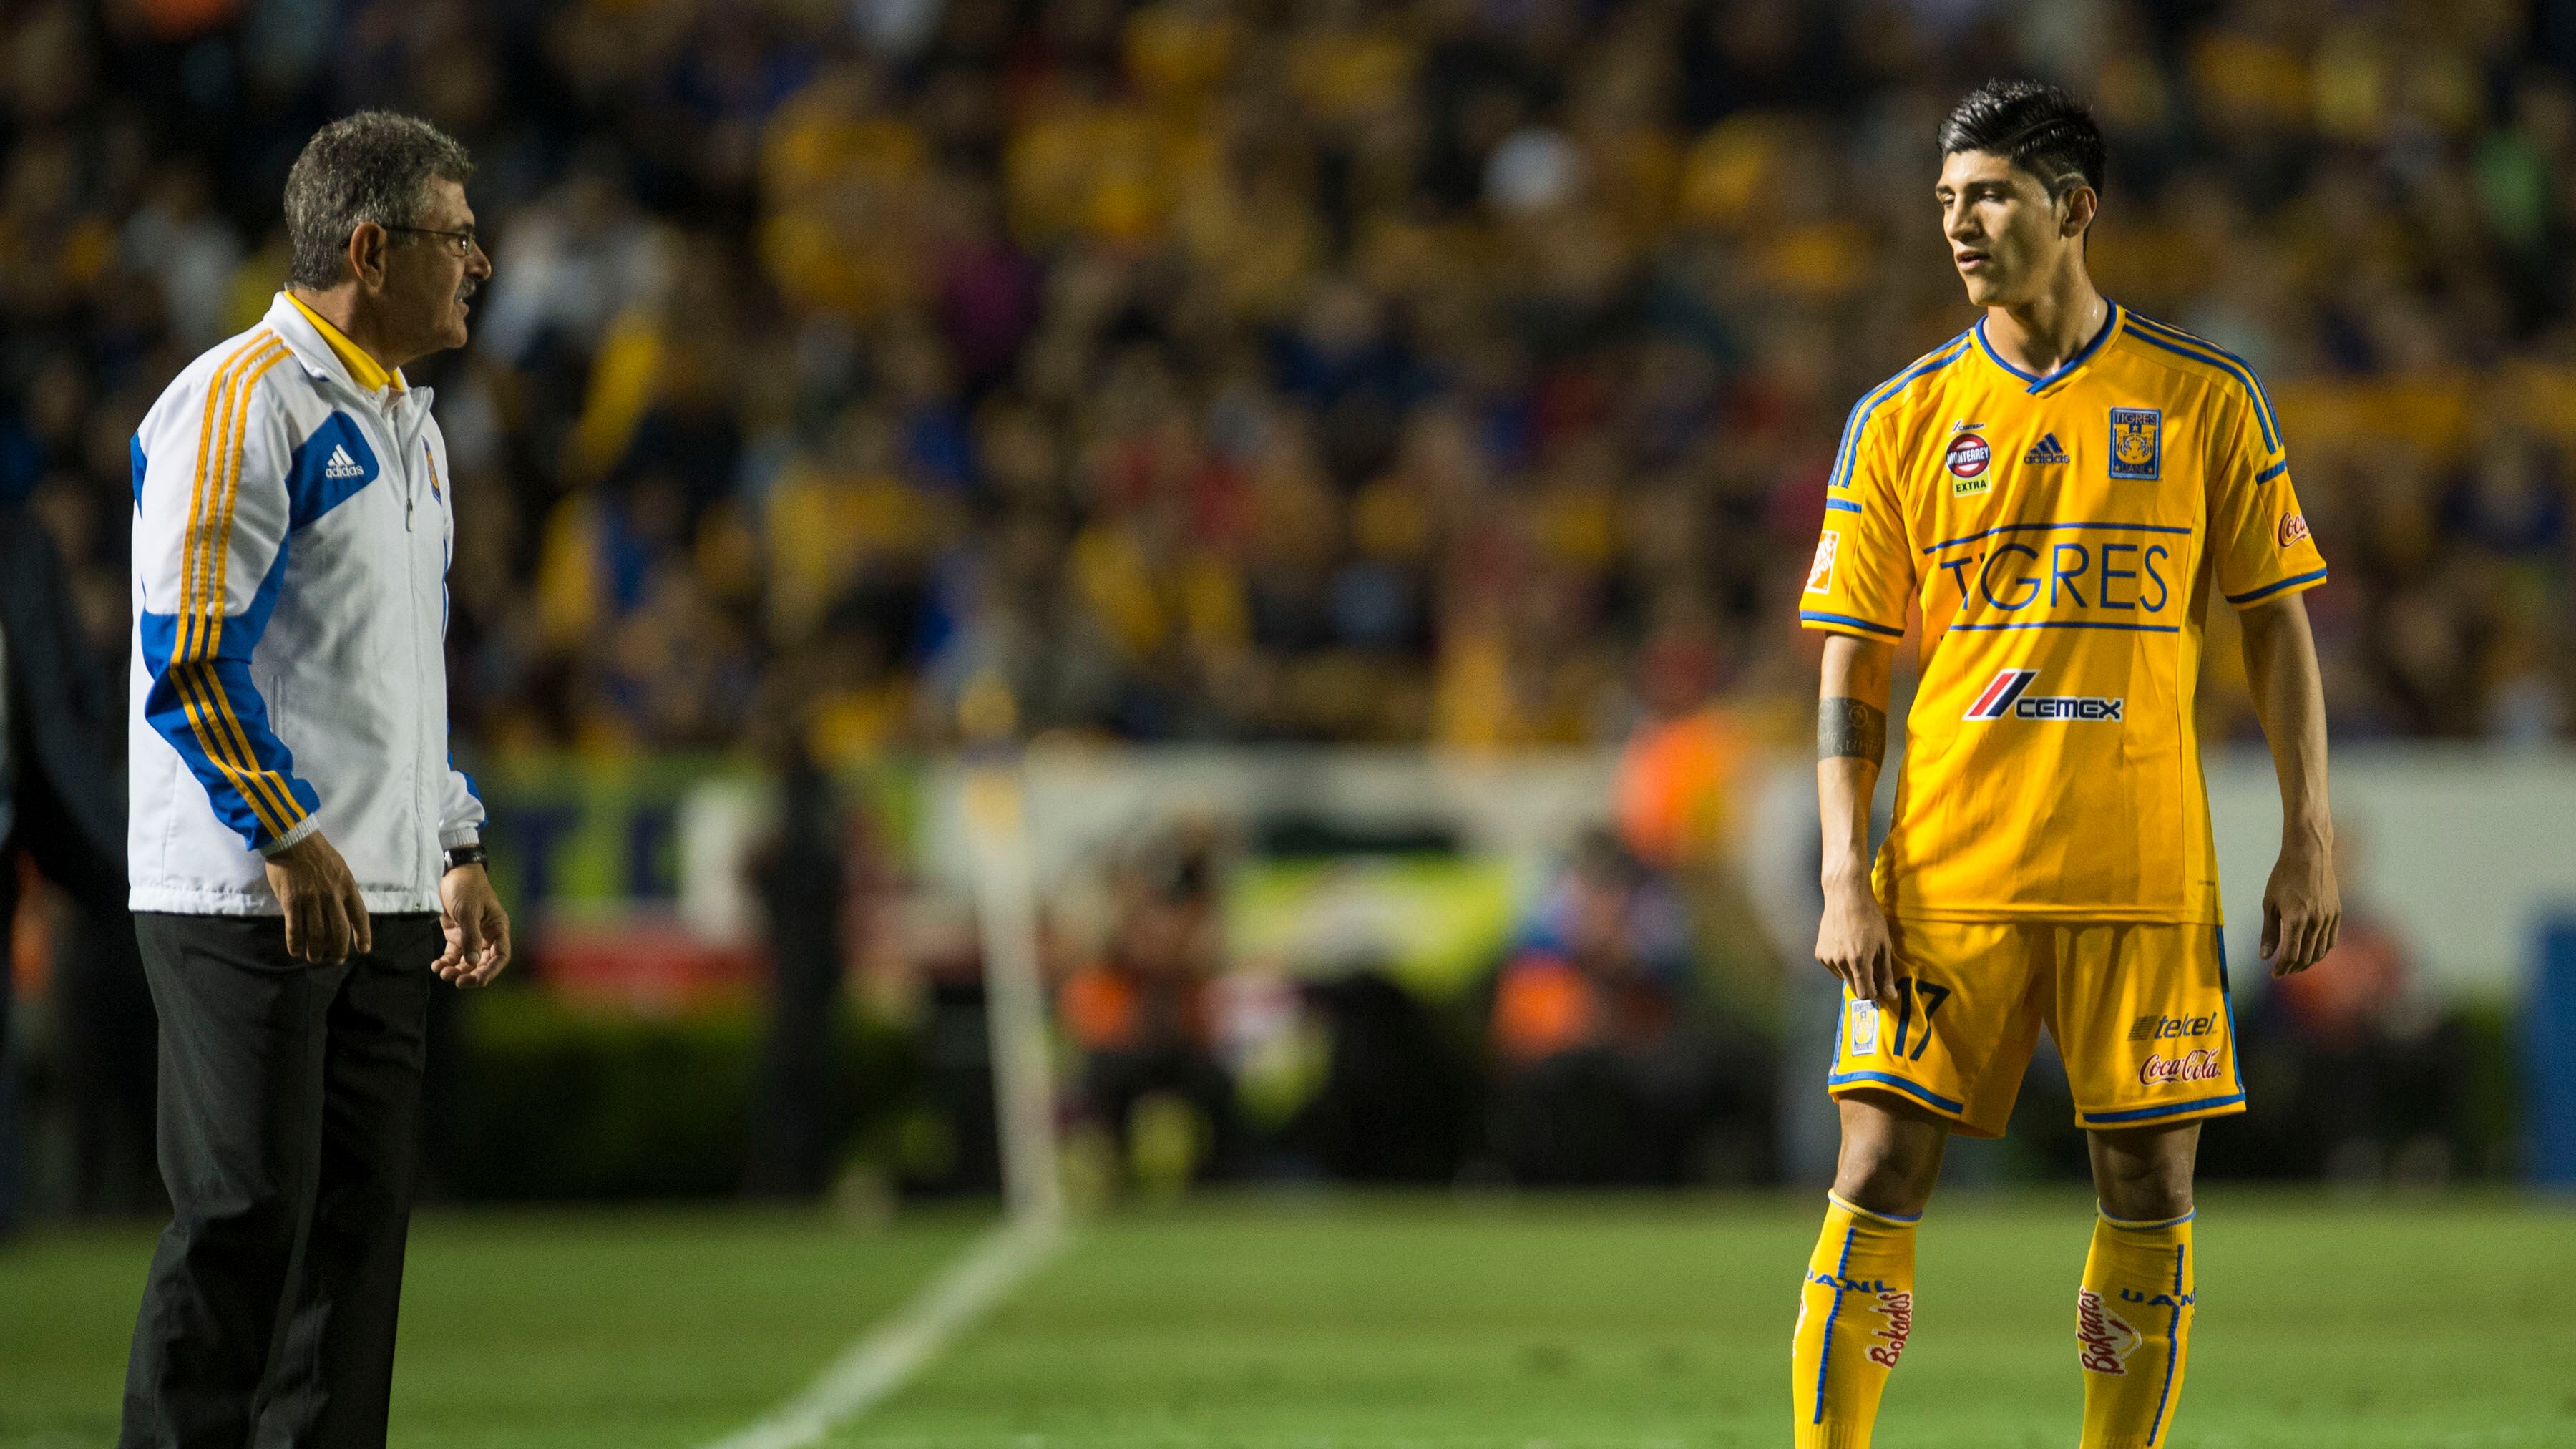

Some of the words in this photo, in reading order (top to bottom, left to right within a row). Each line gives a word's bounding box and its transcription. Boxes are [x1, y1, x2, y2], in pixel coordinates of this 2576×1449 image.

[2115, 412, 2156, 424] TIGRES
[1947, 447, 1989, 464] MONTERREY
[2024, 452, 2070, 464] adidas
[326, 464, 364, 478] adidas
[1956, 480, 1986, 492] EXTRA
[1940, 543, 2168, 613] TGRES
[2016, 698, 2122, 718] CEMEX
[1893, 977, 1951, 1061] 17
[2155, 1011, 2218, 1039] telcel
[2139, 1049, 2219, 1085] Coca-Cola
[1807, 1269, 1897, 1293] UANL
[1870, 1293, 1911, 1367] Bokados
